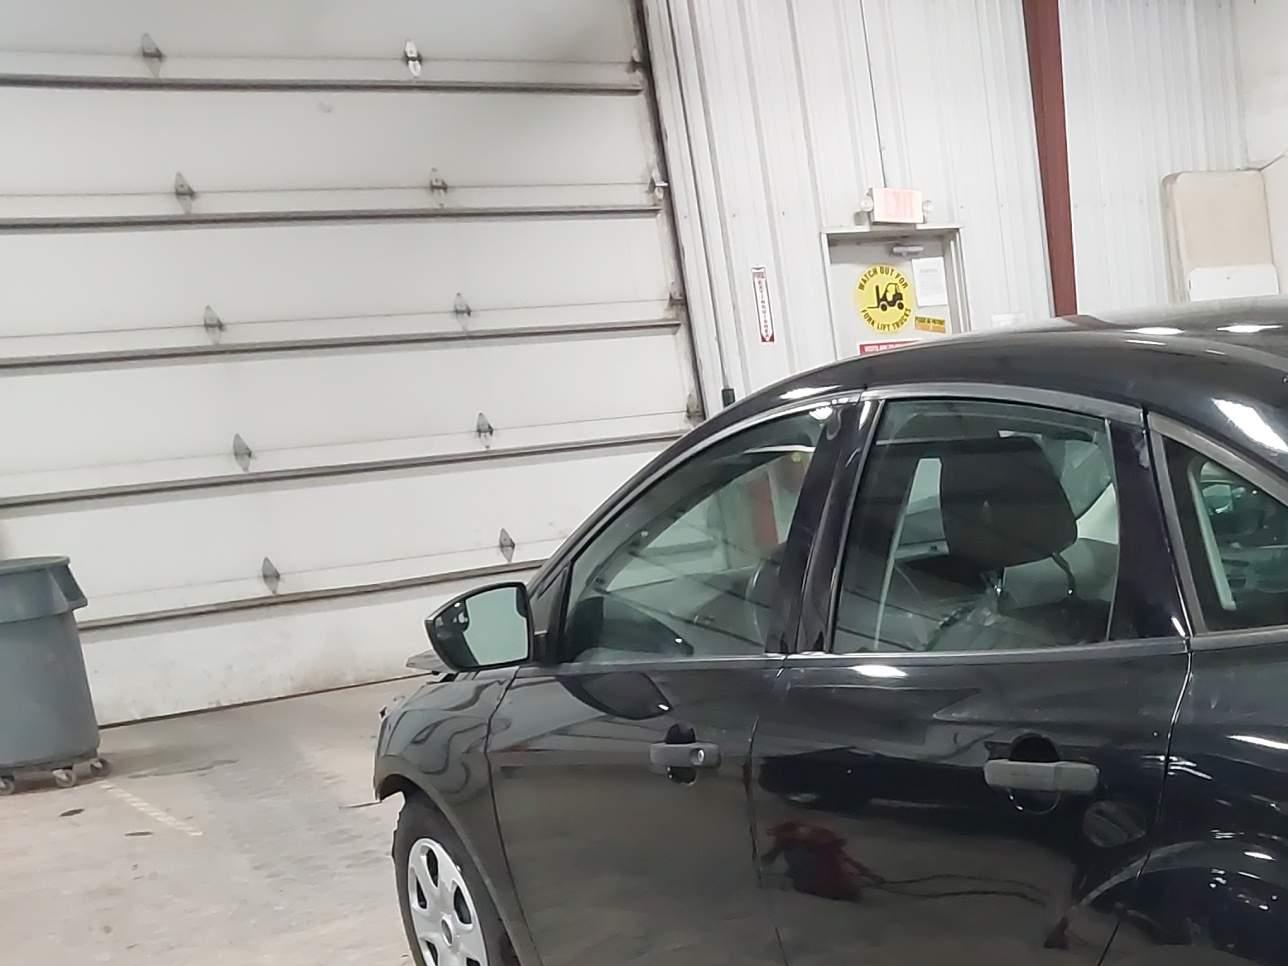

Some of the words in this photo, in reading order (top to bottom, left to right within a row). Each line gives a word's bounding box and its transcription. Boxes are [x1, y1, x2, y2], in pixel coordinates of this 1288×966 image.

[858, 266, 878, 291] WATCH
[879, 265, 894, 277] OUT
[894, 272, 909, 289] FOR
[860, 308, 875, 327] FORK
[876, 322, 891, 332] LIFT
